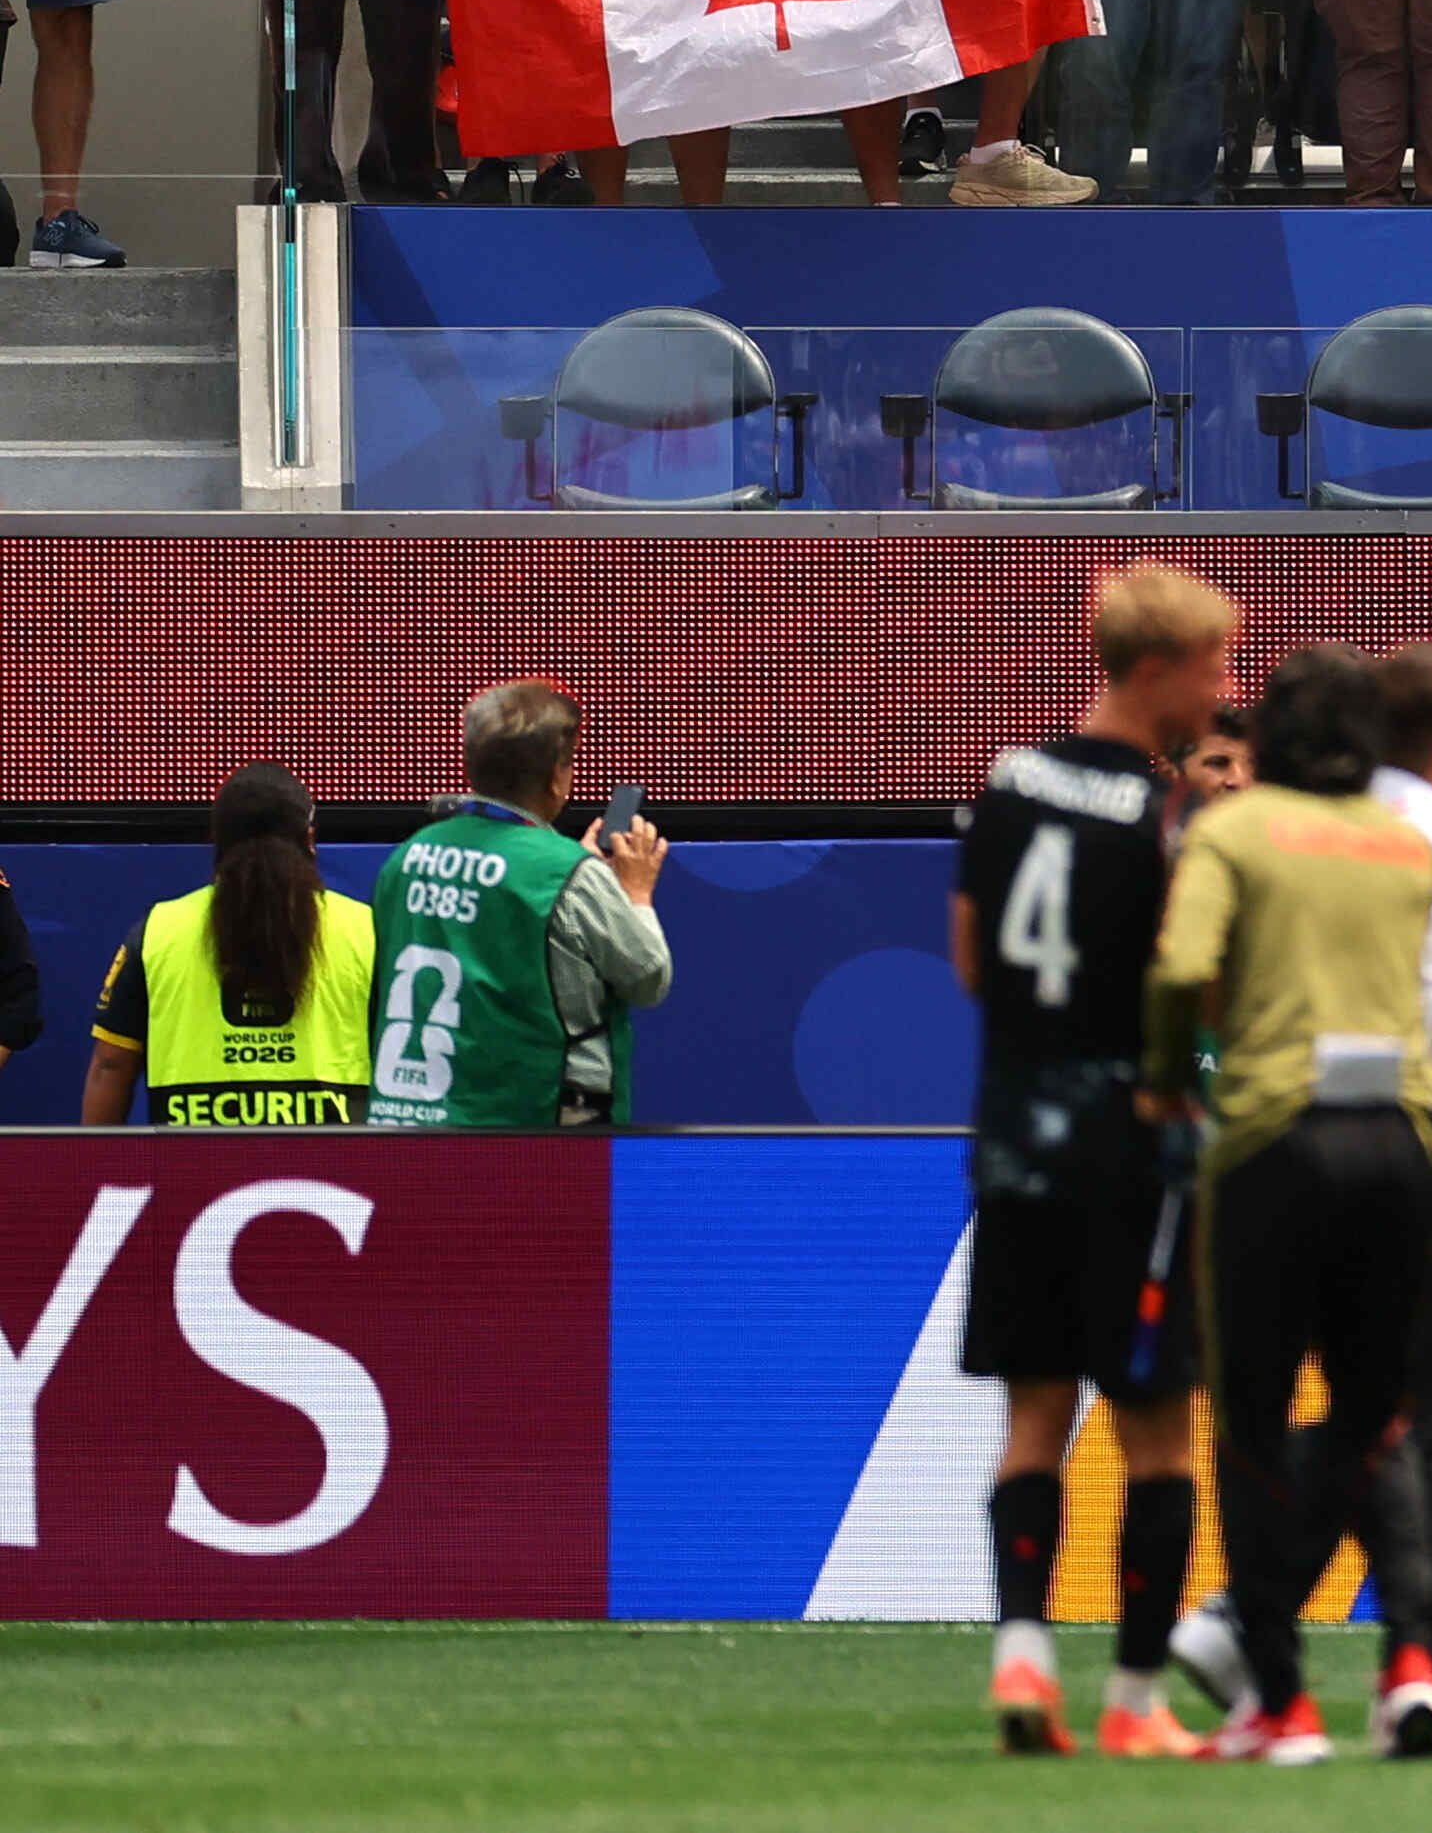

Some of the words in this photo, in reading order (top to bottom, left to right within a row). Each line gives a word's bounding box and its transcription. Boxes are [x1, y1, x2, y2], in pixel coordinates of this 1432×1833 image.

[402, 843, 506, 887] PHOTO
[407, 879, 480, 923] 0385
[1001, 823, 1079, 1007] 4
[223, 1033, 266, 1045] WORLD
[269, 1032, 296, 1044] CUP
[223, 1045, 296, 1064] 2026
[392, 1064, 430, 1088] FIFA
[168, 1089, 352, 1126] SECURITY
[417, 1104, 449, 1123] CUP
